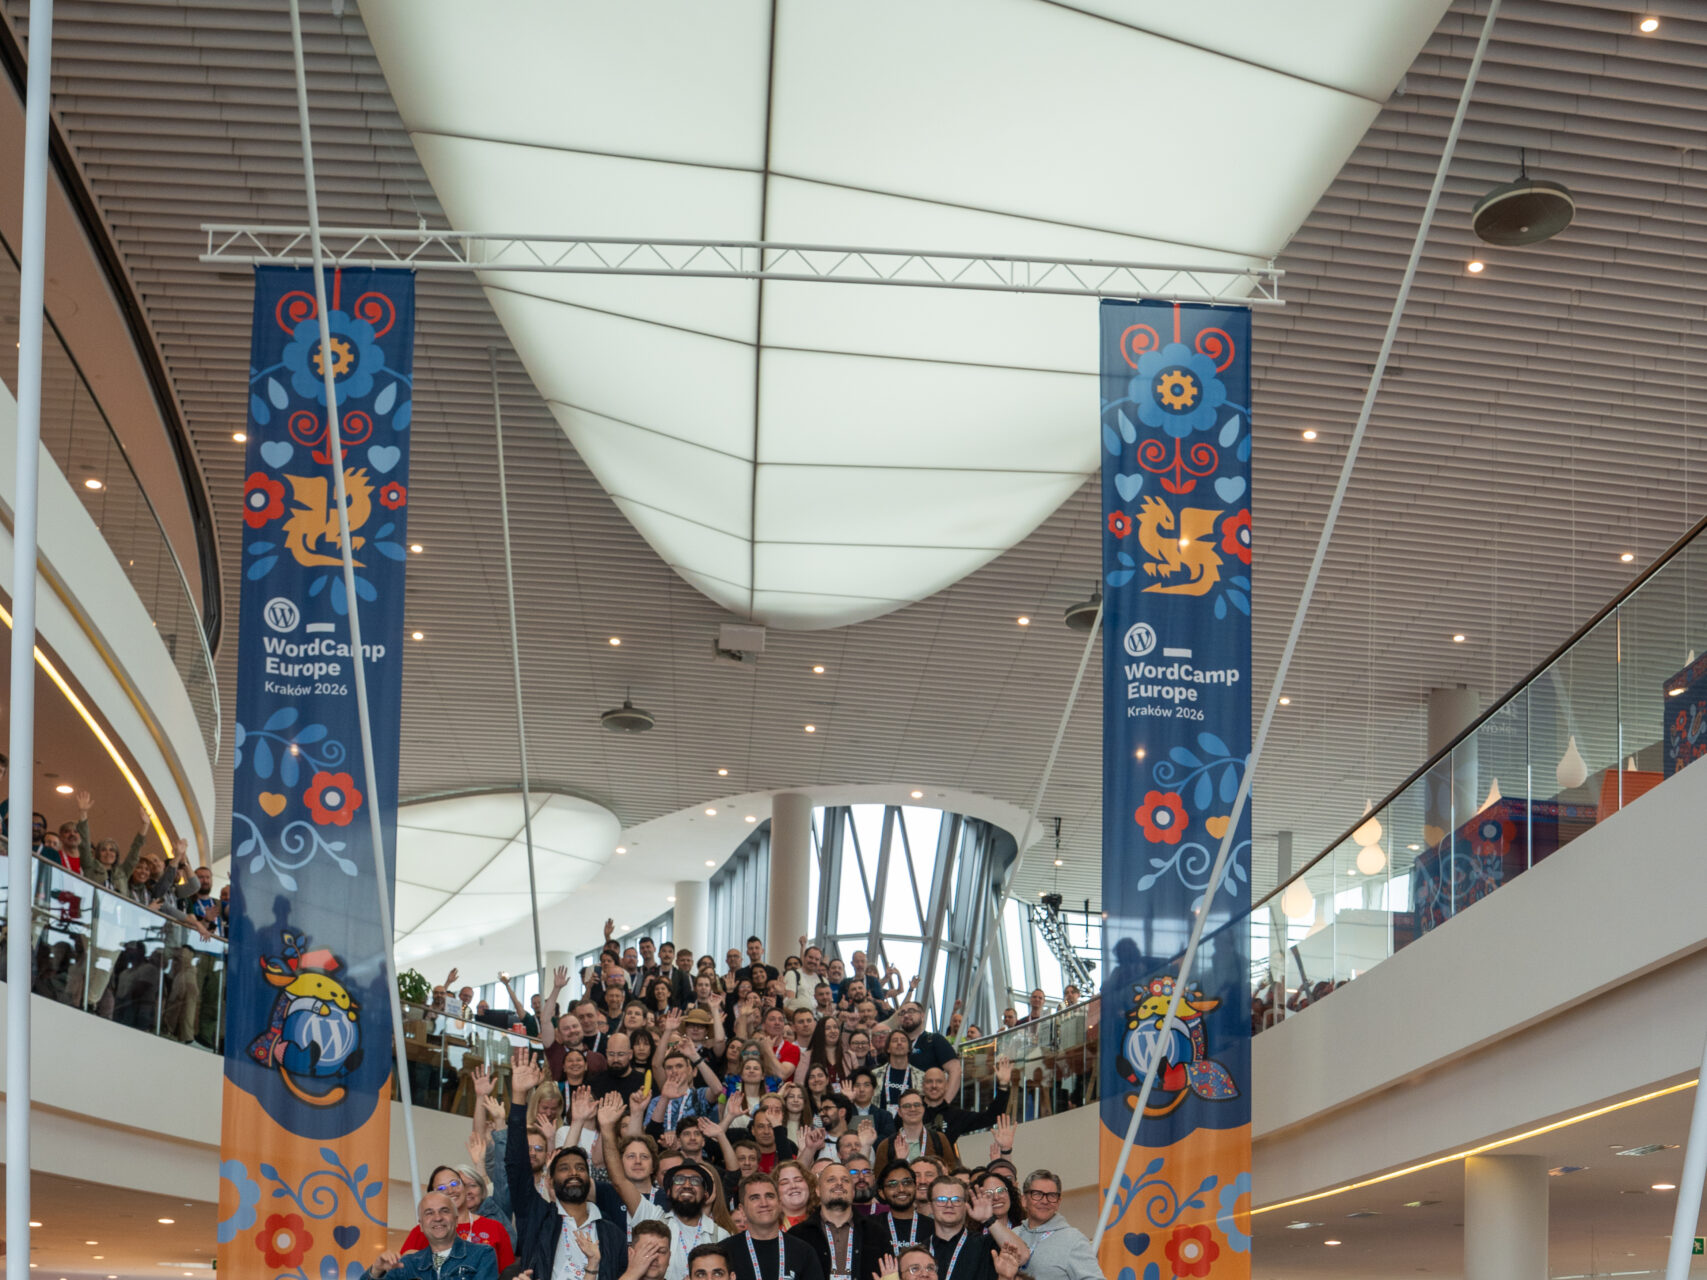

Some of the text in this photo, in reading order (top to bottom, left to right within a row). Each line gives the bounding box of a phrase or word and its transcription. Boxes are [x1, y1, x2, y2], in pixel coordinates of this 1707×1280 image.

[263, 636, 386, 662] WordCamp
[265, 657, 341, 679] Europe
[1124, 662, 1239, 686] WordCamp
[264, 681, 348, 696] Kraków 2026
[1128, 682, 1198, 704] Europe
[1127, 705, 1204, 721] Kraków 2026
